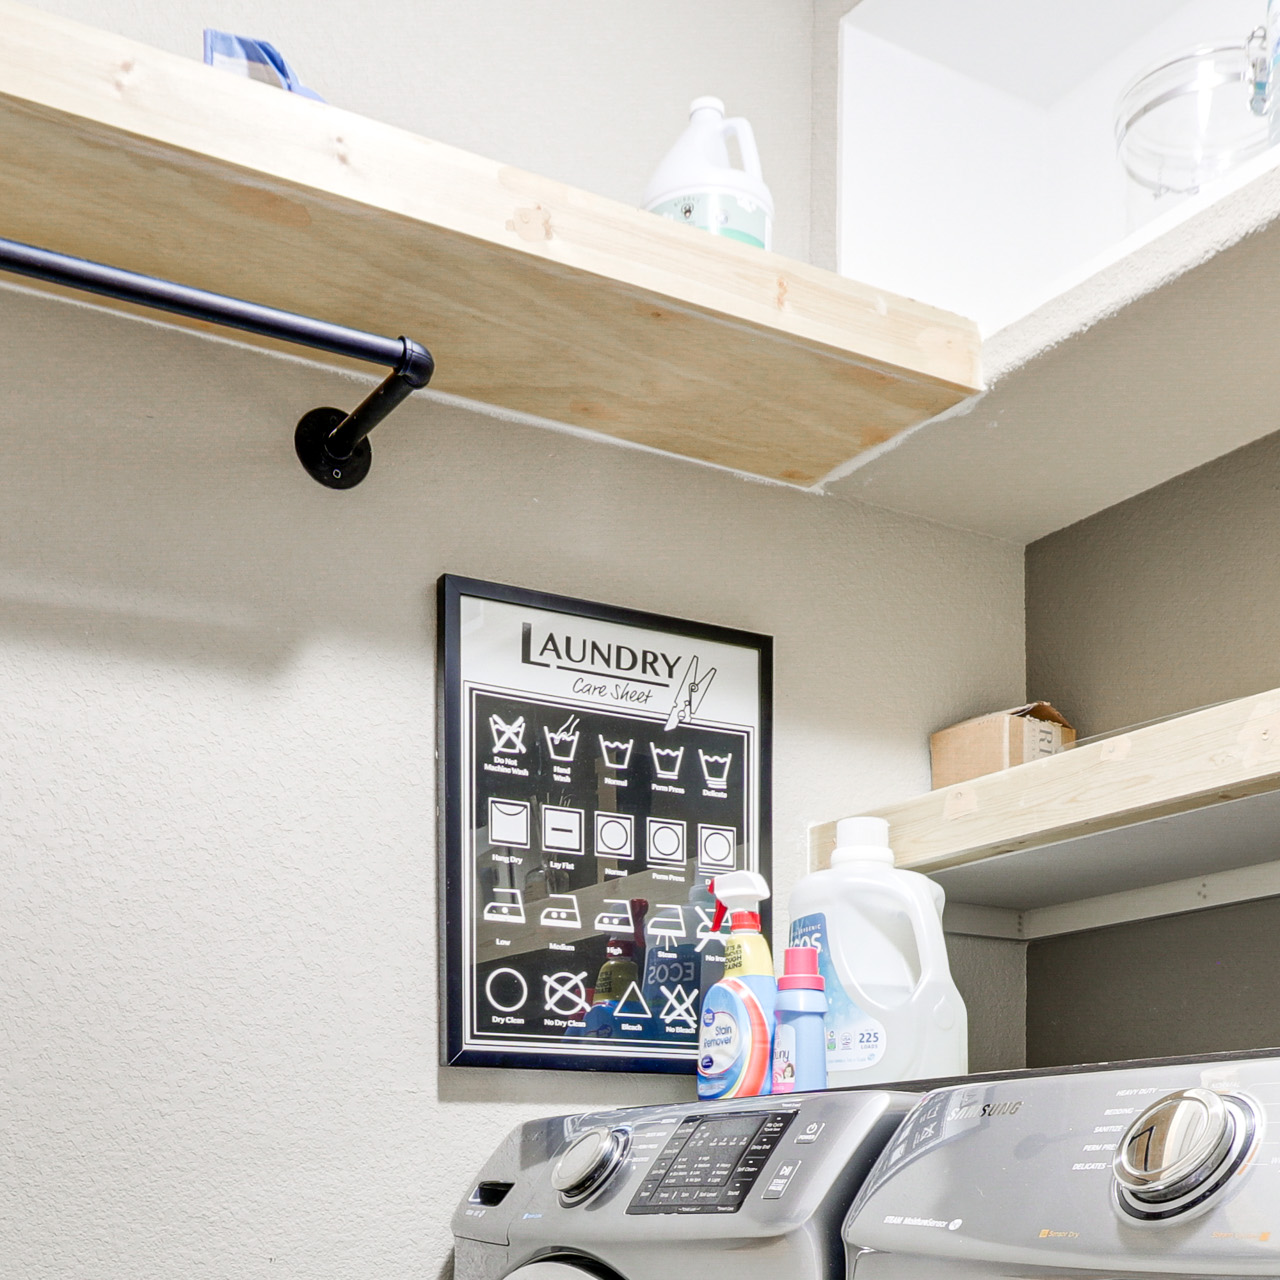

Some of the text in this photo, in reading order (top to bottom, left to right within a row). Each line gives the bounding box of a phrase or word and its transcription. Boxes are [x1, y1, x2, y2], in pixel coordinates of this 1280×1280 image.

[521, 622, 682, 679] LAUNDRY
[572, 677, 653, 705] Care Sheet
[493, 756, 518, 766] Do Not
[484, 763, 512, 774] Machine
[553, 765, 571, 775] Hand
[604, 777, 628, 787] Normal
[651, 783, 685, 795] Perm Press
[702, 789, 728, 799] Delicate
[492, 854, 523, 865] Hang Dry
[549, 860, 575, 870] Lay Flat
[604, 867, 628, 877] Normal
[652, 873, 686, 883] Perm Press
[495, 938, 511, 946] Low
[549, 942, 575, 951] Medium
[606, 946, 622, 956] High
[657, 951, 678, 959] Steam
[705, 954, 714, 962] No
[725, 955, 742, 963] OUGH
[725, 961, 742, 970] TAINS
[492, 1015, 525, 1025] Dry Clean
[544, 1018, 587, 1028] No Dry Clean
[621, 1023, 643, 1031] Bleach
[675, 1026, 696, 1034] Bleach
[715, 1025, 732, 1036] Stain
[703, 1036, 732, 1048] Remover
[858, 1032, 879, 1043] 225
[1116, 1087, 1158, 1096] HEAVY DUTY
[947, 1101, 1023, 1121] SAMSUNG
[1104, 1107, 1134, 1116] BEDDING
[1093, 1125, 1124, 1134] SANITIZE
[1082, 1144, 1102, 1152] PERM
[1072, 1162, 1107, 1170] DELICATES
